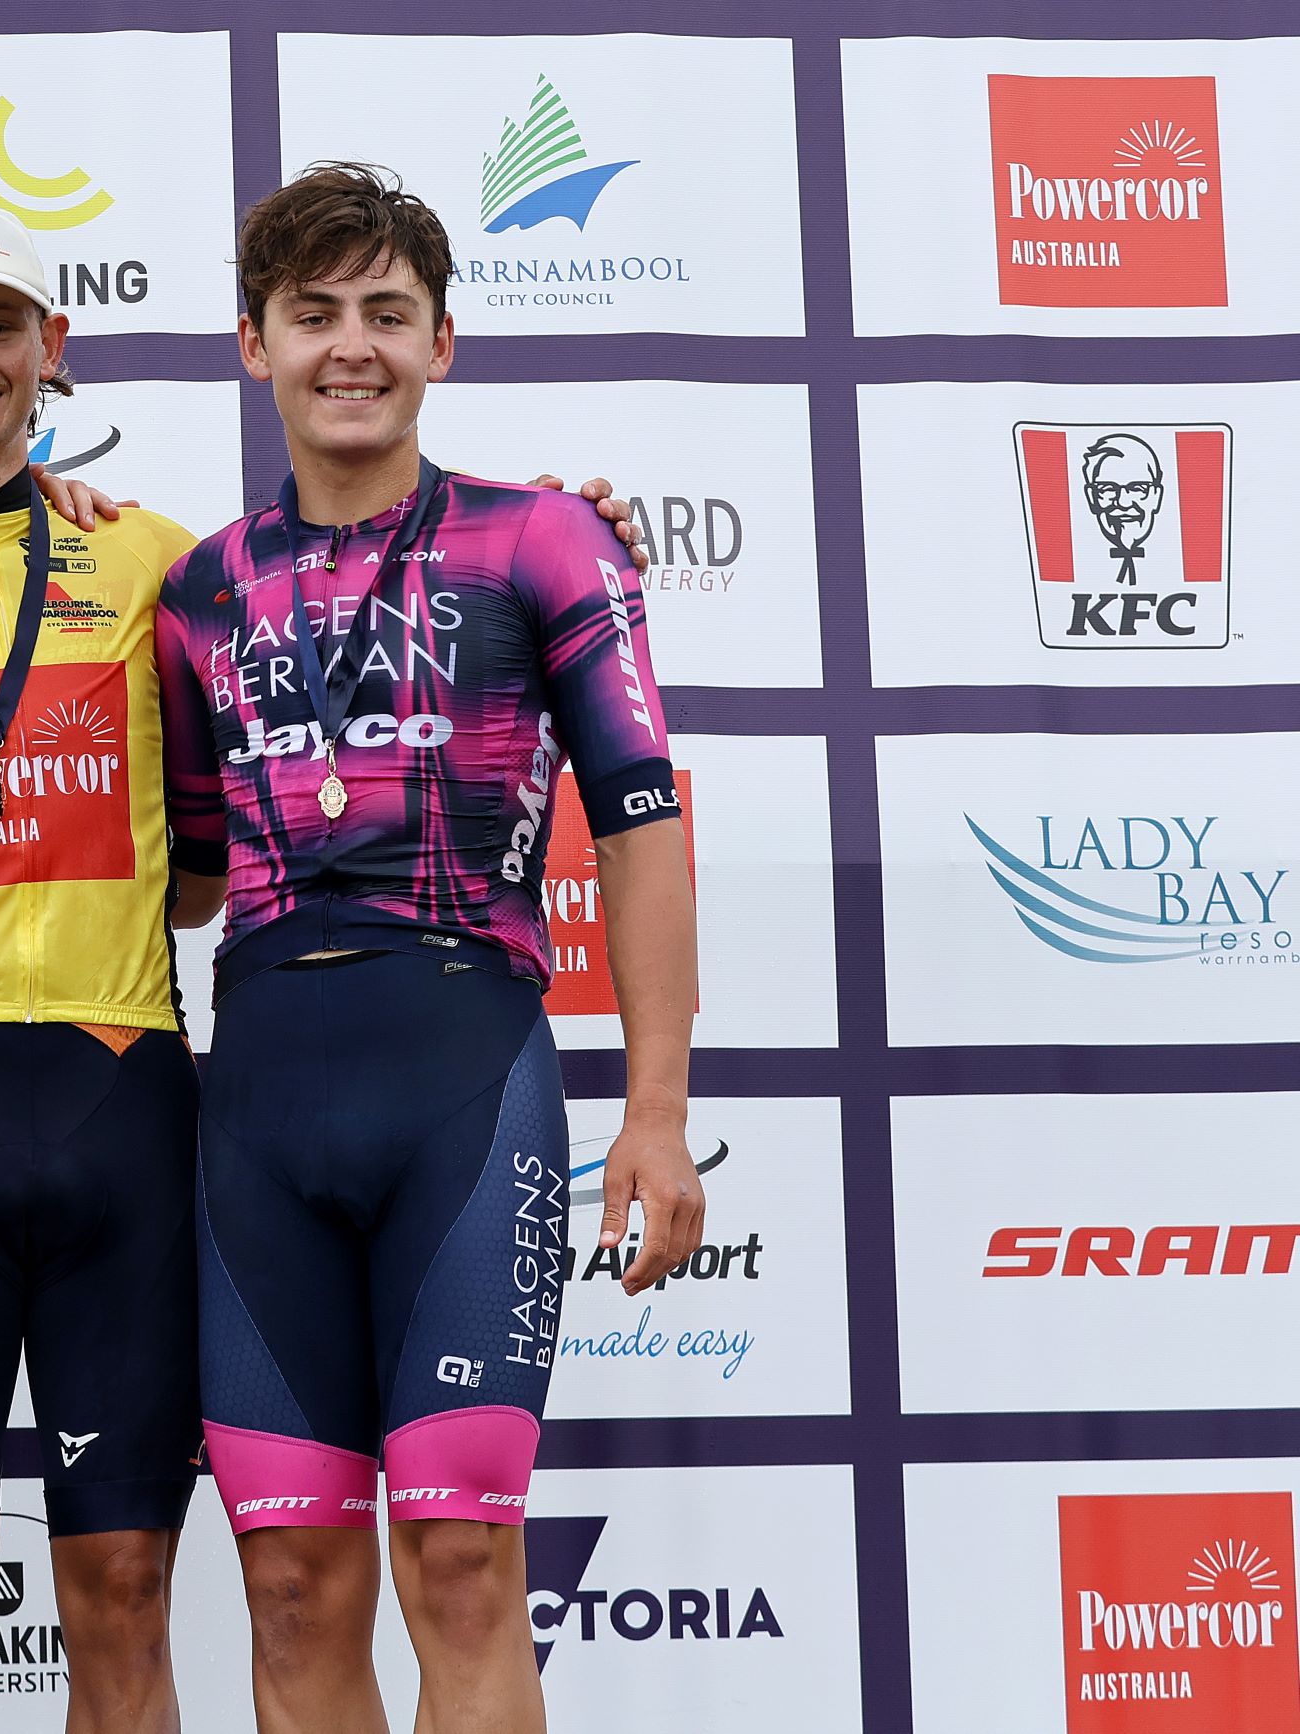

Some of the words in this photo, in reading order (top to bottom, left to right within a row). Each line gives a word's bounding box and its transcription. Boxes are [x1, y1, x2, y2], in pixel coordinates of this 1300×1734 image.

[1006, 162, 1208, 221] Powercor
[447, 257, 690, 283] ARRNAMBOOL
[1011, 239, 1121, 267] AUSTRALIA
[487, 294, 527, 307] CITY
[533, 292, 614, 306] COUNCIL
[53, 543, 89, 553] League
[71, 562, 91, 570] MEN
[363, 550, 447, 565] AEON
[43, 600, 94, 609] ELBOURNE
[234, 579, 249, 590] UCI
[211, 591, 463, 673] HAGENS
[1066, 592, 1198, 636] KFC
[596, 557, 657, 745] GIANT
[227, 713, 454, 764] Jayco
[501, 711, 561, 883] Jayco
[1036, 816, 1219, 870] LADY
[1153, 870, 1290, 925] BAY
[505, 1151, 542, 1365] HAGENS
[536, 1168, 564, 1369] BERMAN
[560, 1305, 670, 1357] made
[677, 1328, 756, 1380] easy
[236, 1496, 320, 1516] GIANT
[391, 1487, 459, 1502] GIANT
[526, 1587, 785, 1641] CTORIA
[1077, 1590, 1283, 1651] Powercor
[1080, 1671, 1193, 1701] AUSTRALIA
